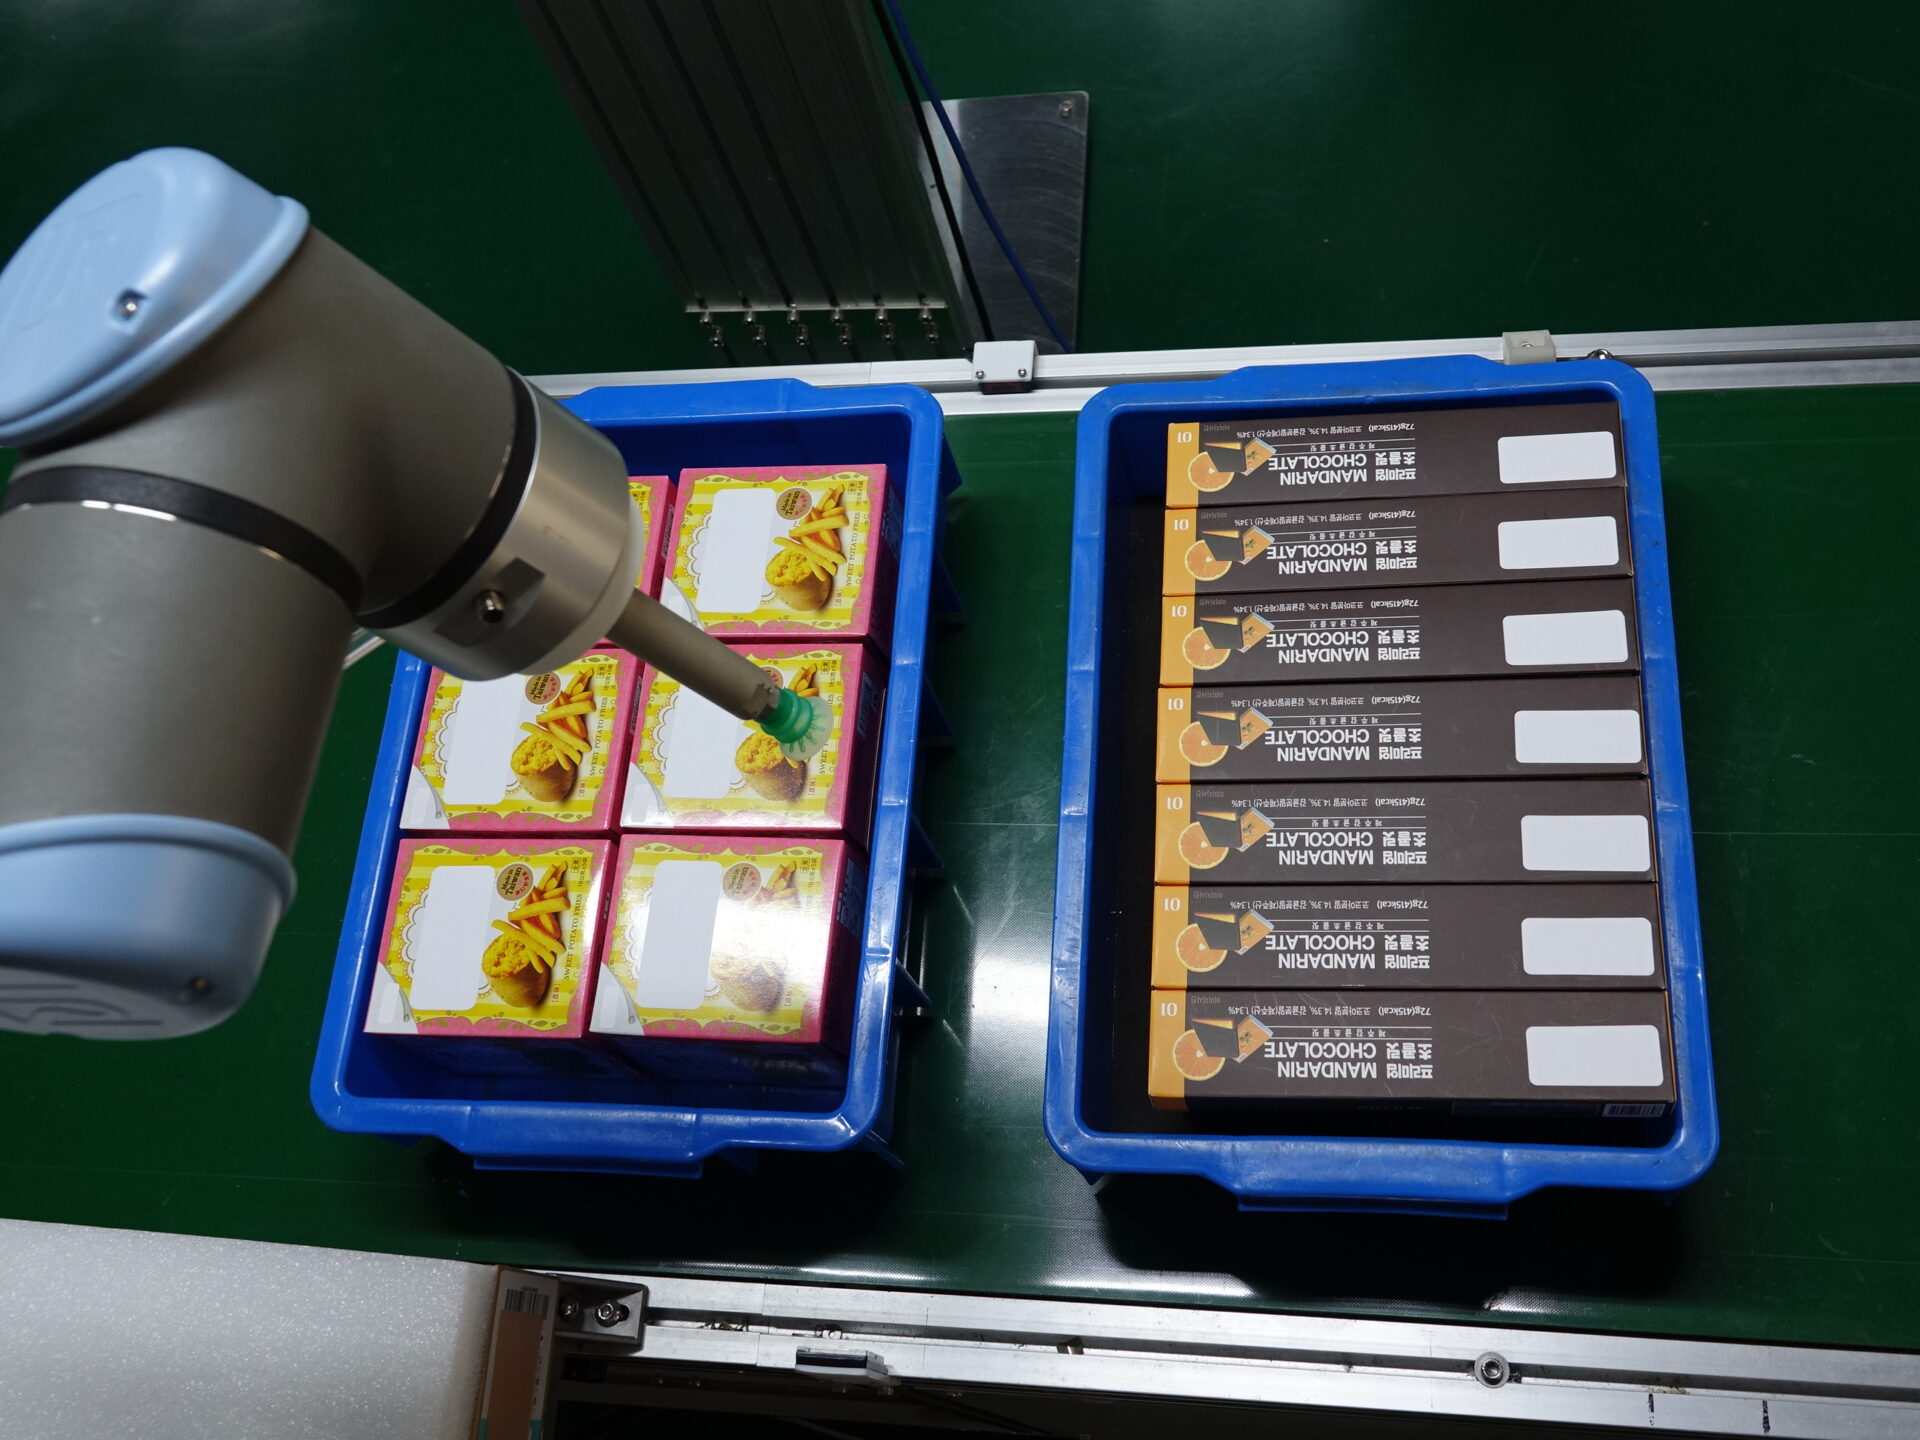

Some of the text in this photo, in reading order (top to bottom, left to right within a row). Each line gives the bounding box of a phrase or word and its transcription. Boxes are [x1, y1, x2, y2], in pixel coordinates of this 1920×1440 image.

[1237, 431, 1256, 439] 1.34%
[1330, 426, 1362, 434] 코코아분말
[1368, 423, 1415, 432] 72g(415kcal)
[1268, 453, 1367, 471] CHOCOLATE
[1375, 451, 1416, 466] 초콜릿
[1280, 469, 1367, 485] MANDARIN
[1375, 468, 1416, 481] 프리미엄
[785, 490, 800, 515] Taiwan
[1329, 513, 1362, 522] 코코아분말
[1368, 510, 1416, 520] 72g(415kcal)
[1234, 519, 1254, 527] 1.34%
[849, 533, 858, 560] POTATO
[1266, 542, 1367, 559] CHOCOLATE
[1375, 540, 1417, 555] 초콜릿
[1279, 557, 1367, 574] MANDARIN
[1376, 557, 1417, 570] 프리미엄
[846, 563, 854, 586] SWEET
[1233, 606, 1254, 614] 1.34%
[1330, 601, 1364, 610] 코코아분말
[1370, 599, 1419, 608] 72g(415kcal)
[1266, 631, 1369, 648] CHOCOLATE
[1377, 629, 1420, 644] 초콜릿
[1278, 647, 1369, 664] MANDARIN
[1378, 647, 1420, 661] 프리미엄
[534, 674, 549, 699] Taiwan
[1231, 699, 1252, 709] 1.34%
[1330, 697, 1364, 706] 코코아분말
[1371, 694, 1421, 704] 72g(415kcal)
[590, 697, 607, 776] SWEET POTATO FRIES
[1264, 728, 1369, 745] CHOCOLATE
[1378, 727, 1422, 743] 초콜릿
[1277, 746, 1370, 762] MANDARIN
[1379, 746, 1422, 760] 프리미엄
[820, 748, 828, 774] SWEET
[1231, 799, 1253, 809] 1.34%
[1333, 798, 1368, 807] 코코아분말
[1375, 797, 1425, 807] 72g(415kcal)
[1266, 831, 1373, 847] CHOCOLATE
[1382, 831, 1426, 847] 초콜릿
[1279, 850, 1373, 865] MANDARIN
[1383, 850, 1427, 865] 프리미엄
[505, 867, 522, 895] Taiwan
[1230, 901, 1252, 910] 1.34%
[1334, 900, 1369, 910] 코코아분말
[1376, 899, 1428, 909] 72g(415kcal)
[565, 894, 583, 979] SWEET POTATO FRIES
[1265, 934, 1375, 950] CHOCOLATE
[1384, 934, 1429, 951] 초콜릿
[1278, 953, 1375, 969] MANDARIN
[1384, 954, 1430, 969] 프리미엄
[1228, 1006, 1250, 1016] 1.34%
[1334, 1006, 1371, 1016] 코코아분말
[1378, 1006, 1431, 1016] 72g(415kcal)
[1264, 1041, 1376, 1058] CHOCOLATE
[1386, 1042, 1432, 1060] 초콜릿
[1277, 1061, 1377, 1078] MANDARIN
[1386, 1063, 1433, 1079] 프리미엄
